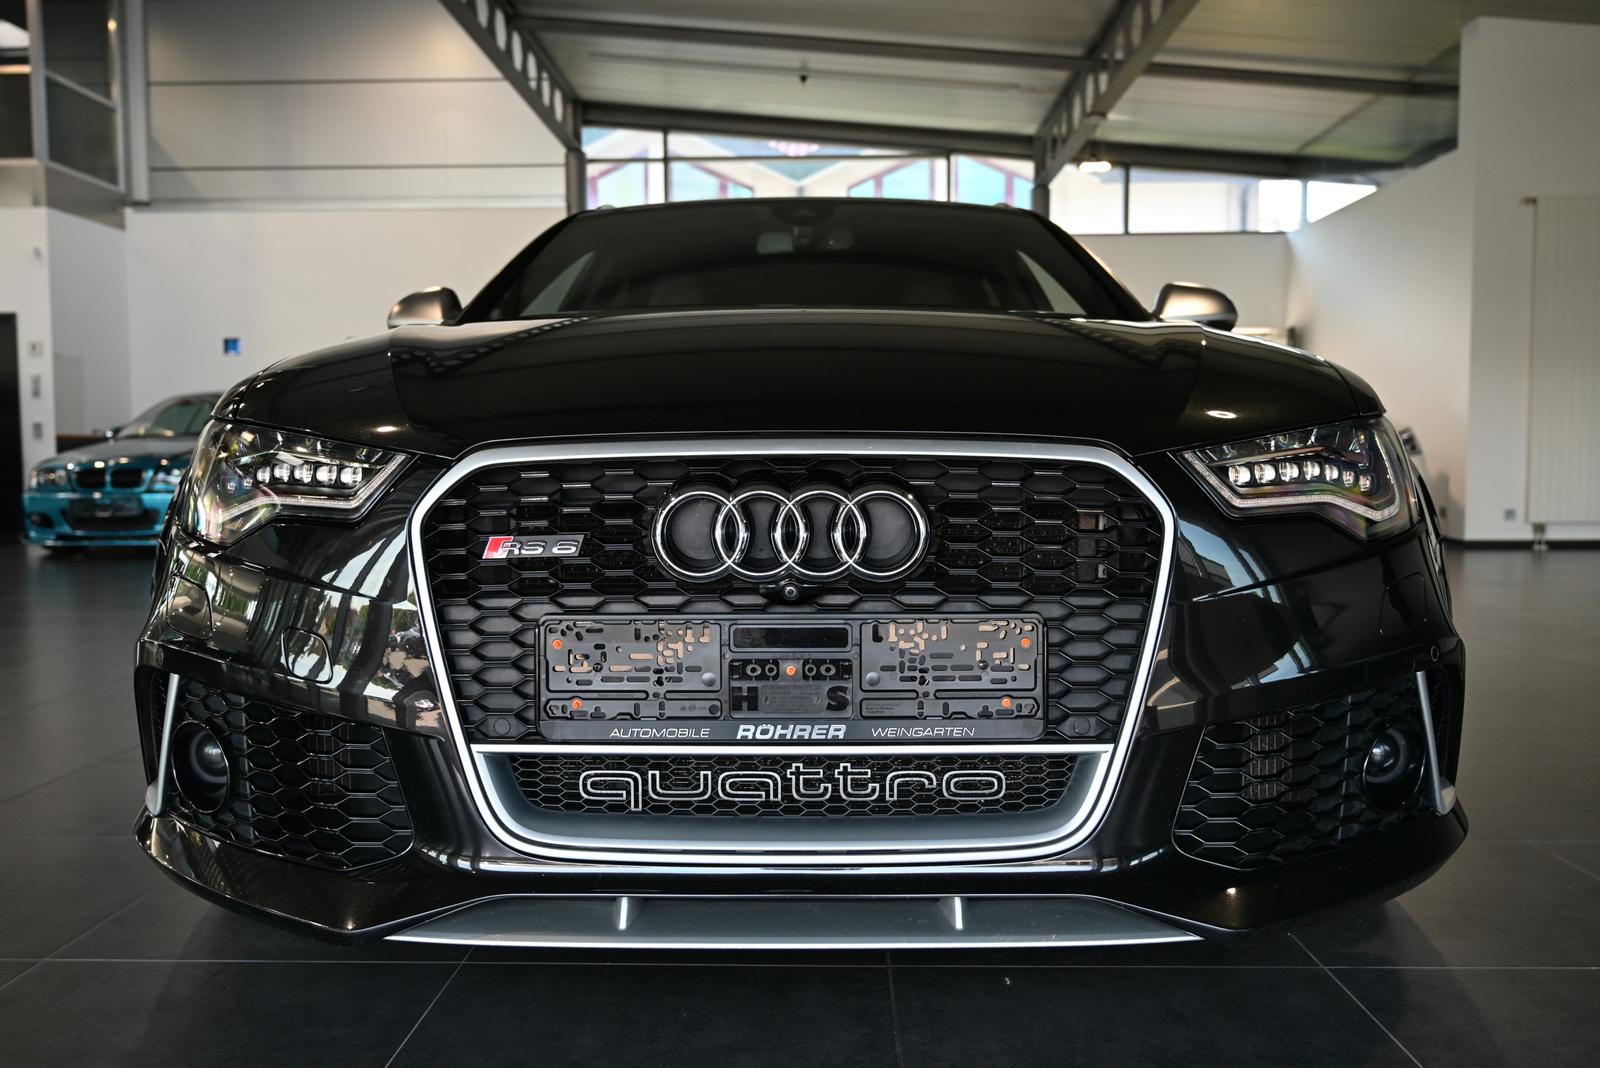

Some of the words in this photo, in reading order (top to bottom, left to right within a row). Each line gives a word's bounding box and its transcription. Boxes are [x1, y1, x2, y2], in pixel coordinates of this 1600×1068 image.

[609, 728, 711, 738] AUTOMOBILE
[736, 723, 847, 740] RÖHRER
[871, 727, 976, 737] WEINGARTEN
[578, 763, 1007, 812] quattro
